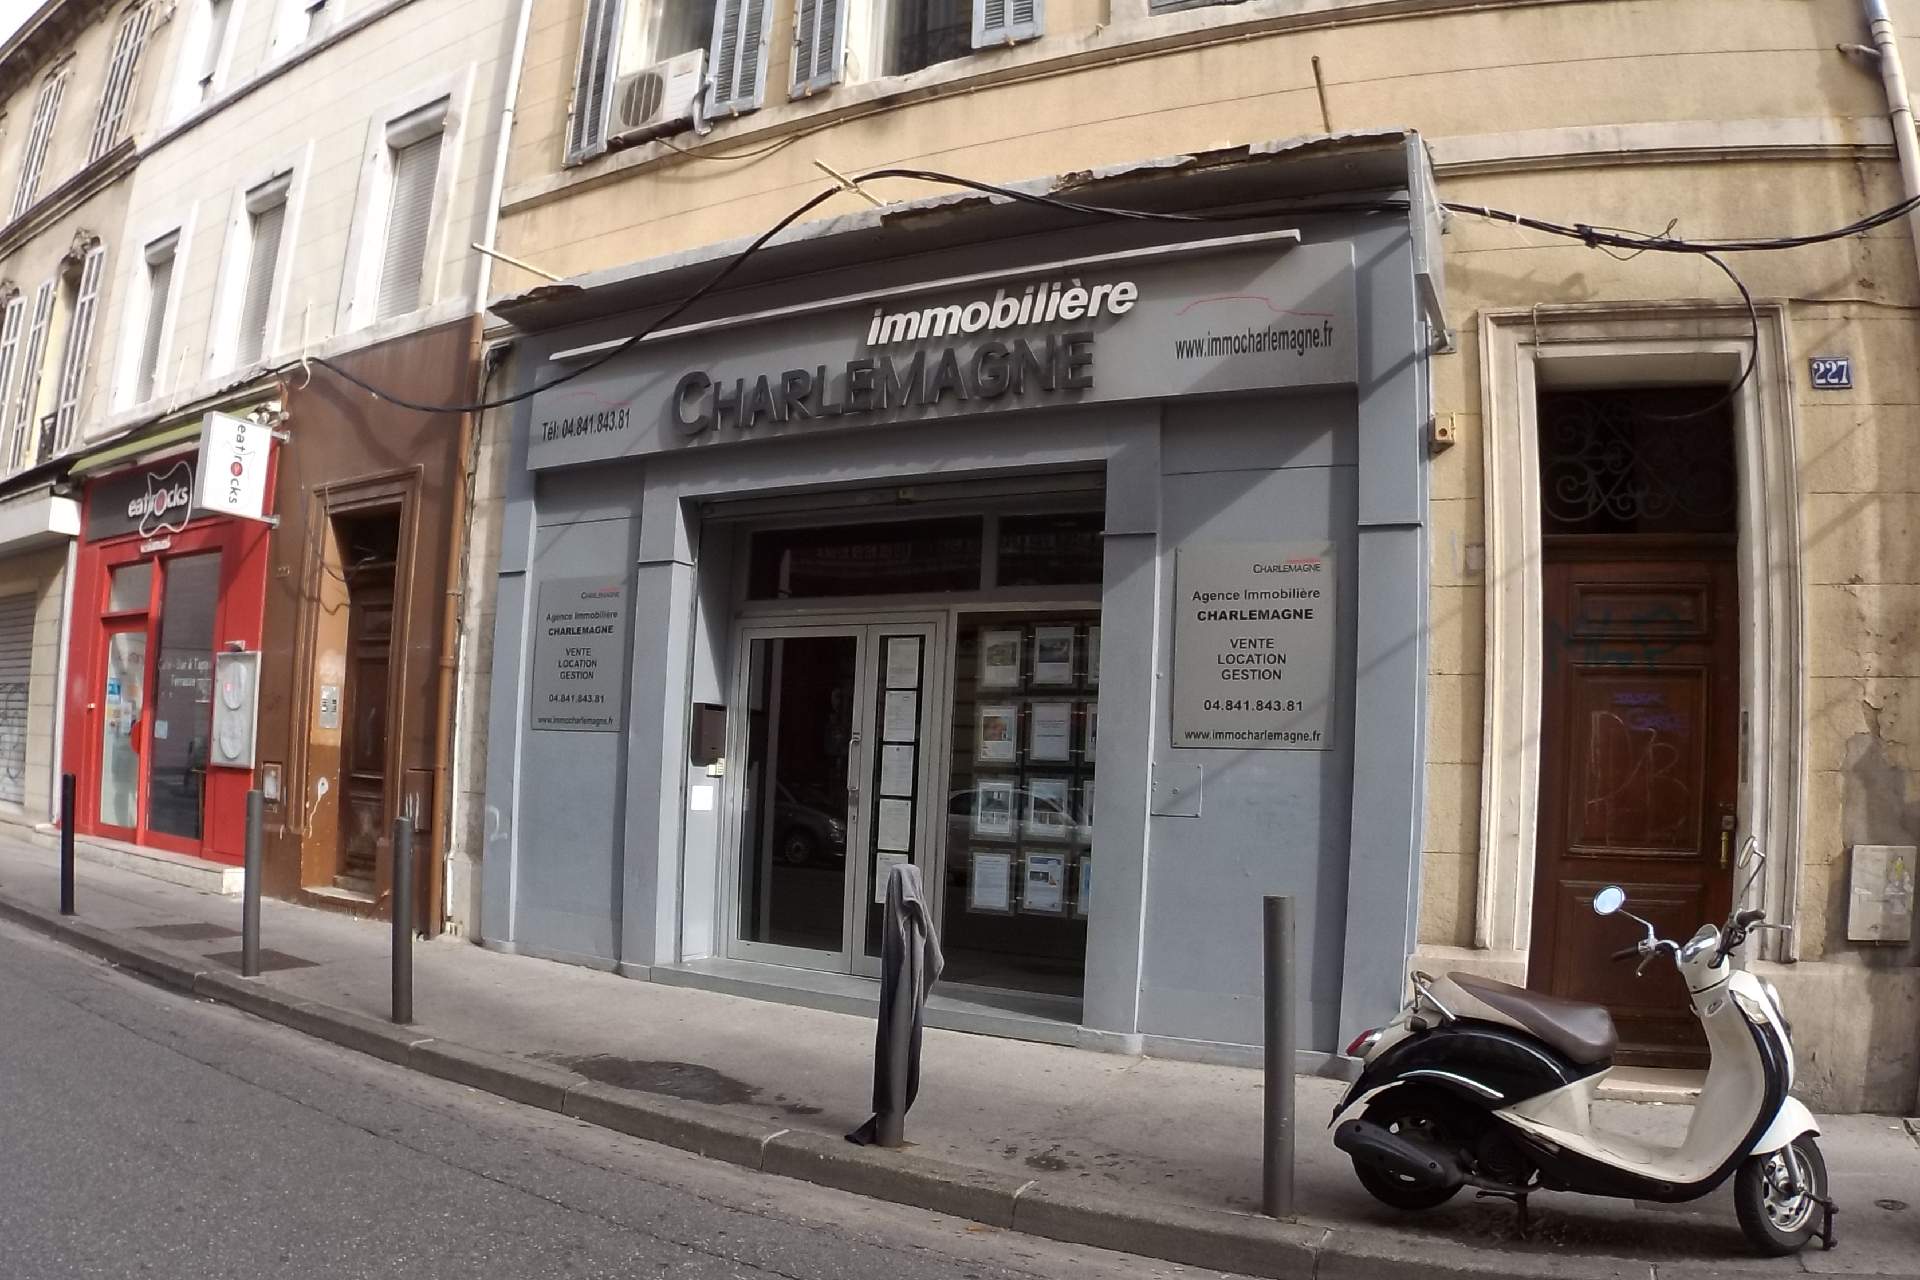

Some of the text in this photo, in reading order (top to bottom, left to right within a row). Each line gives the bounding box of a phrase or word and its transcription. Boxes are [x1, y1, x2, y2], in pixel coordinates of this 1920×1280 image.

[866, 278, 1138, 346] immobilière
[1175, 320, 1333, 359] www.immocharlemagne.fr
[1812, 360, 1849, 384] 227
[671, 331, 1095, 436] CHARLEMAGNE
[562, 408, 630, 438] 04.841.843.81
[1252, 563, 1321, 574] CHARLEMAGNE
[1192, 588, 1321, 604] Agence Immobilière
[546, 612, 573, 623] Agence
[1197, 608, 1314, 621] CHARLEMAGNE
[548, 624, 614, 636] CHARLEMAGNE
[1229, 638, 1275, 649] VENTE
[565, 648, 592, 657] VENTE
[558, 659, 597, 669] LOCATION
[1217, 653, 1287, 665] LOCATION
[560, 671, 594, 680] GESTION
[1221, 669, 1282, 680] GESTION
[1203, 700, 1303, 712] 04.841.843.81
[1184, 729, 1321, 743] www.immocharlemagne.fr
